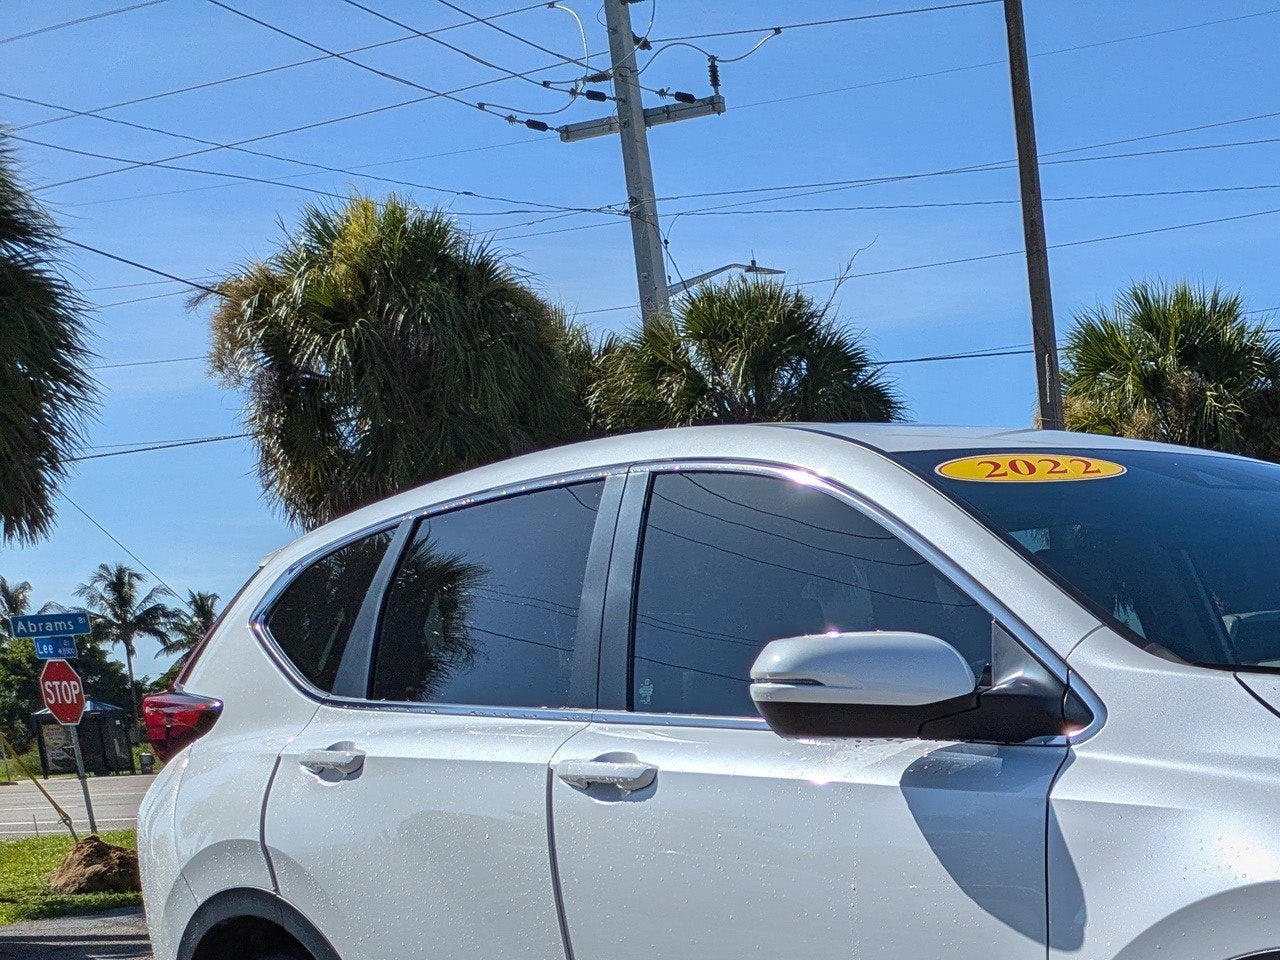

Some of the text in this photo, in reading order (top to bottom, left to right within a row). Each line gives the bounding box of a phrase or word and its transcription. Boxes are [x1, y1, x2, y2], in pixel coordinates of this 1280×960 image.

[977, 458, 1101, 478] 2022
[17, 620, 74, 634] Abrams
[36, 641, 54, 655] Lee
[44, 680, 80, 705] STOP
